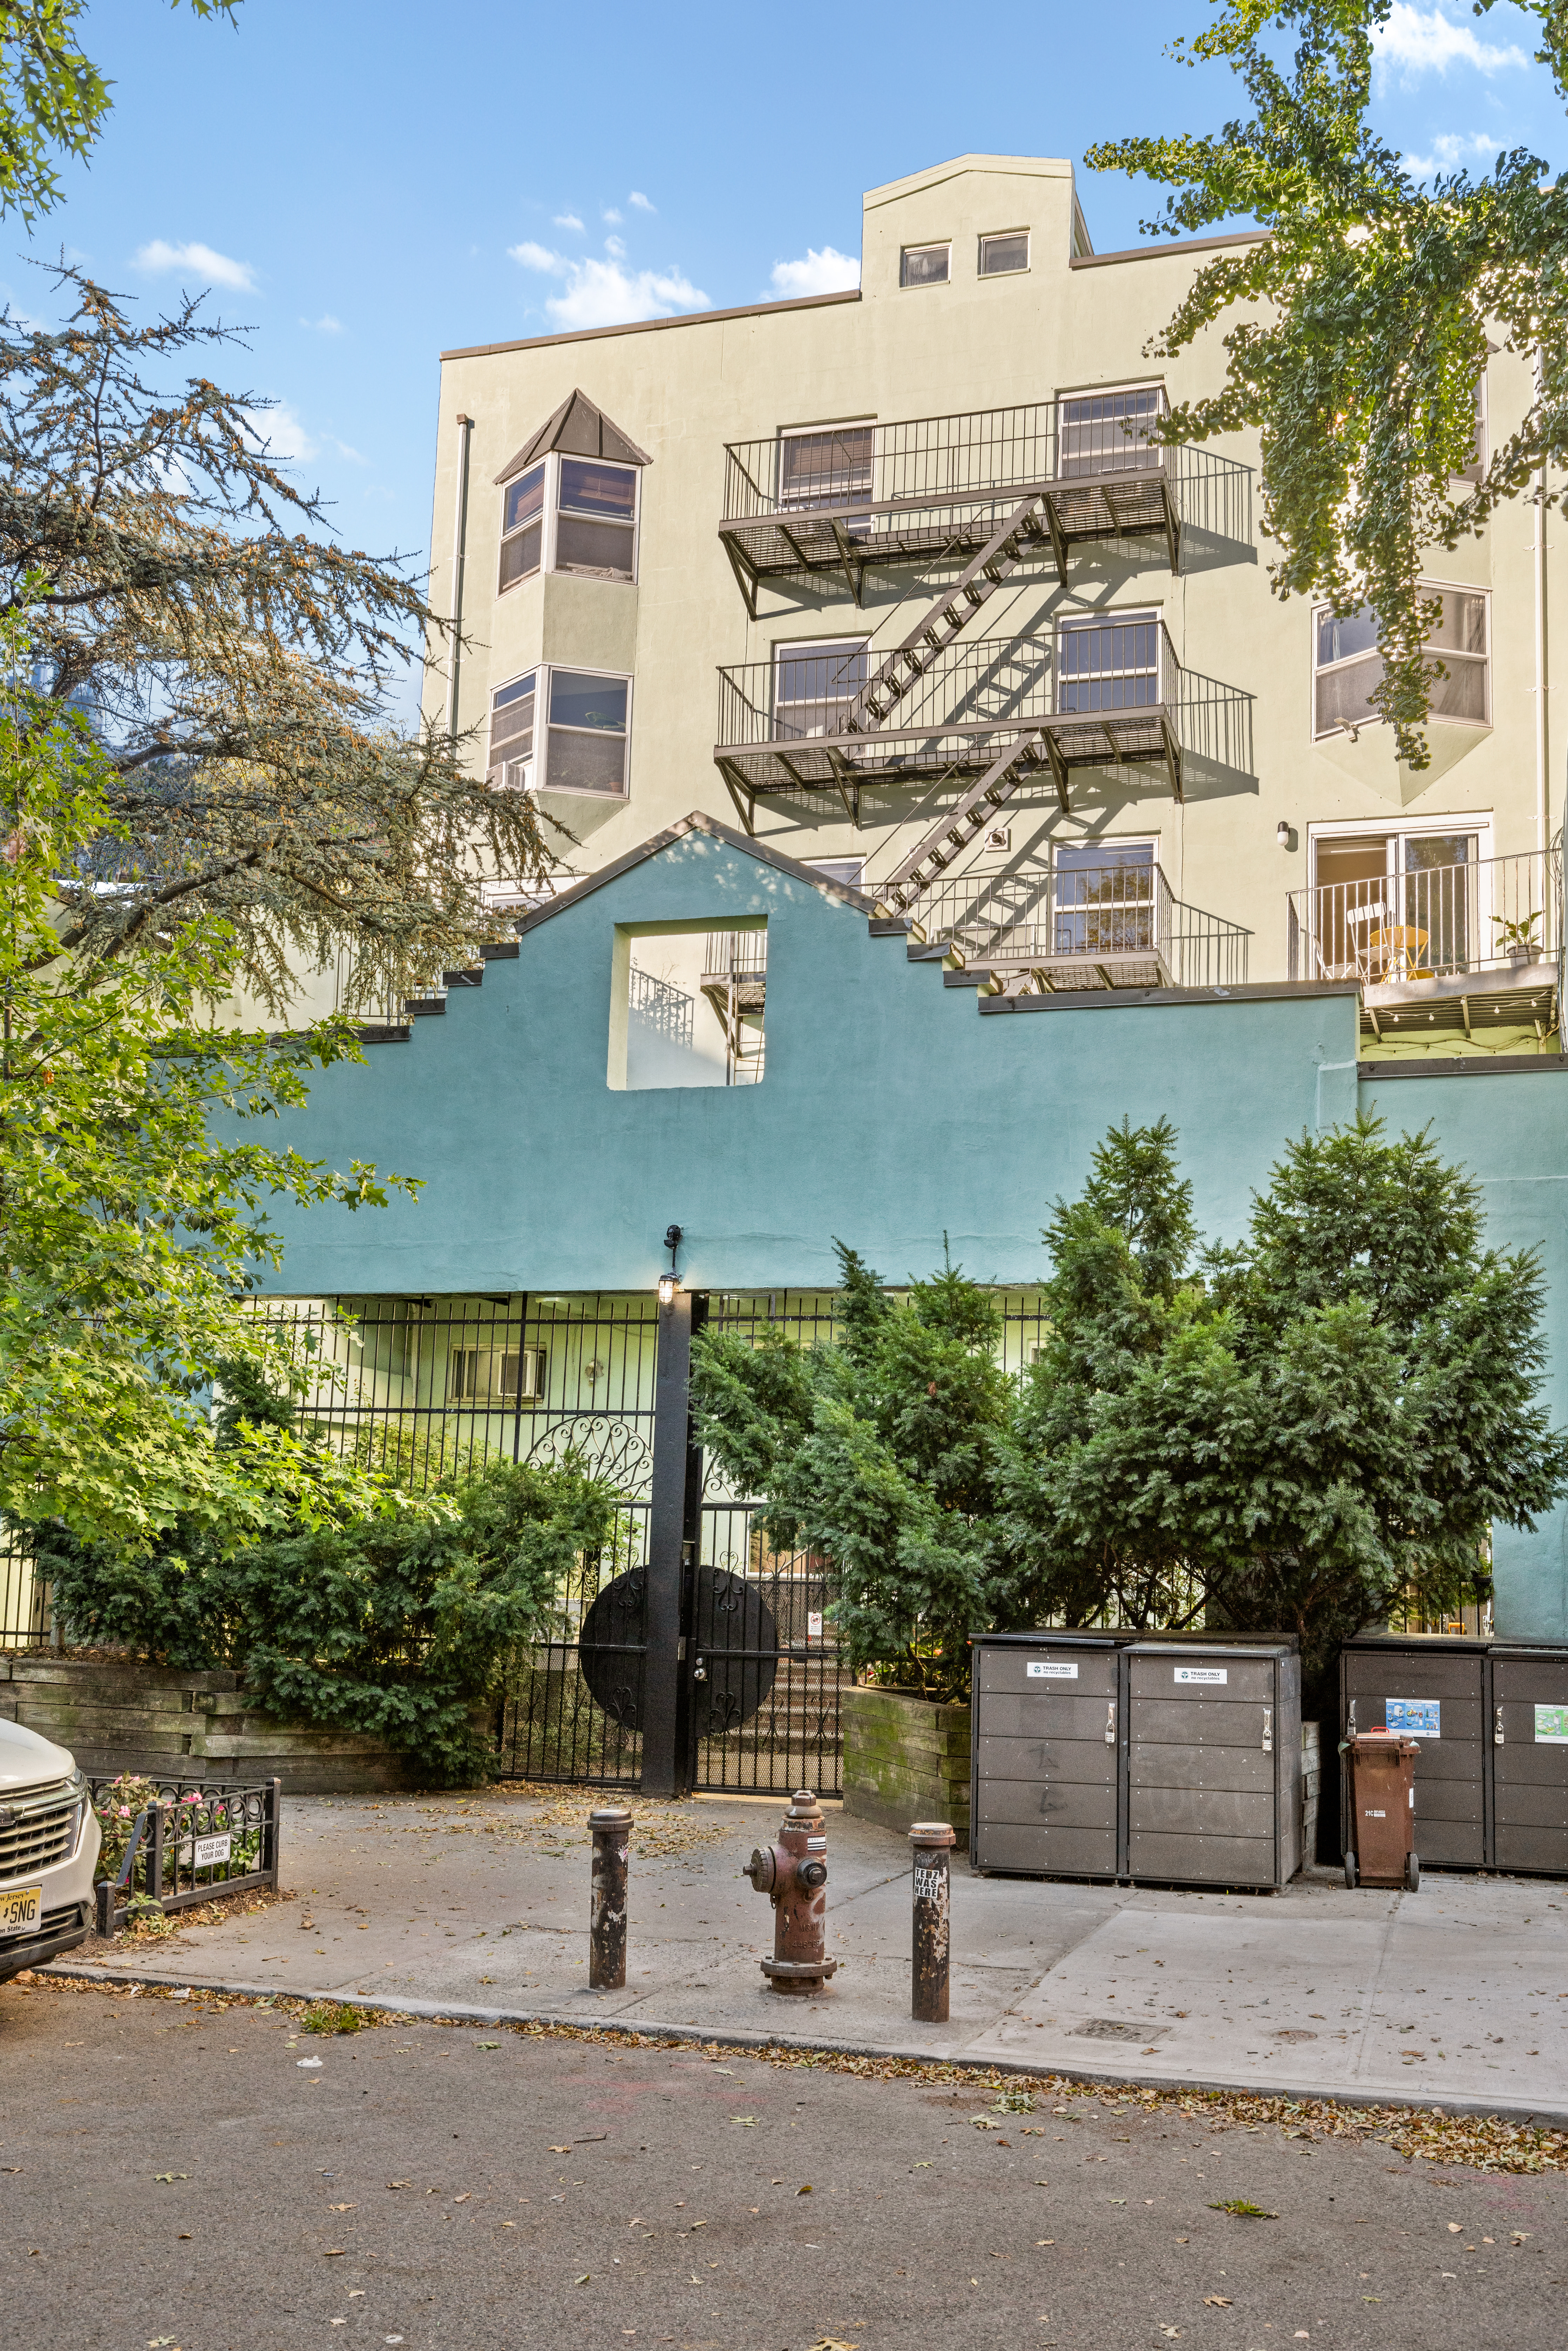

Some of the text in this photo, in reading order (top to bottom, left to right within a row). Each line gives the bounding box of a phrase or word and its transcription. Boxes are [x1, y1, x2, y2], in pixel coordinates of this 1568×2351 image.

[198, 1840, 228, 1852] PLEASE CURB
[202, 1849, 224, 1860] YOUR DOG
[916, 1877, 937, 1888] WAS
[915, 1885, 937, 1897] HERE
[6, 1893, 25, 1902] Jersey
[9, 1899, 36, 1924] SNG
